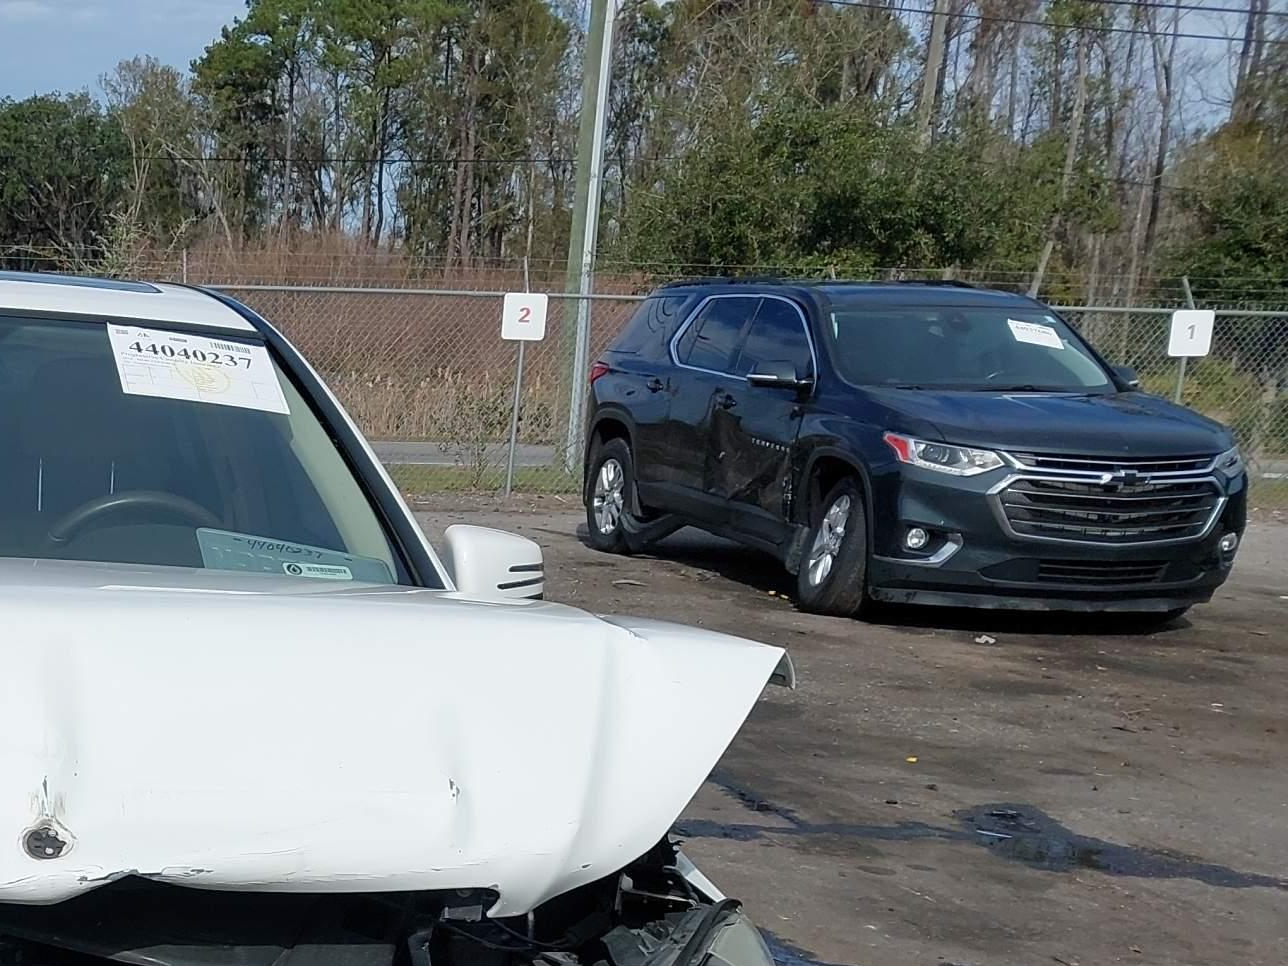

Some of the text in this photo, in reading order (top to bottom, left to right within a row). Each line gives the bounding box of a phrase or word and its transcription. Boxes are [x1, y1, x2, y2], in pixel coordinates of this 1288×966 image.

[518, 307, 532, 323] 2
[1187, 324, 1196, 340] 1
[128, 341, 252, 370] 44040237
